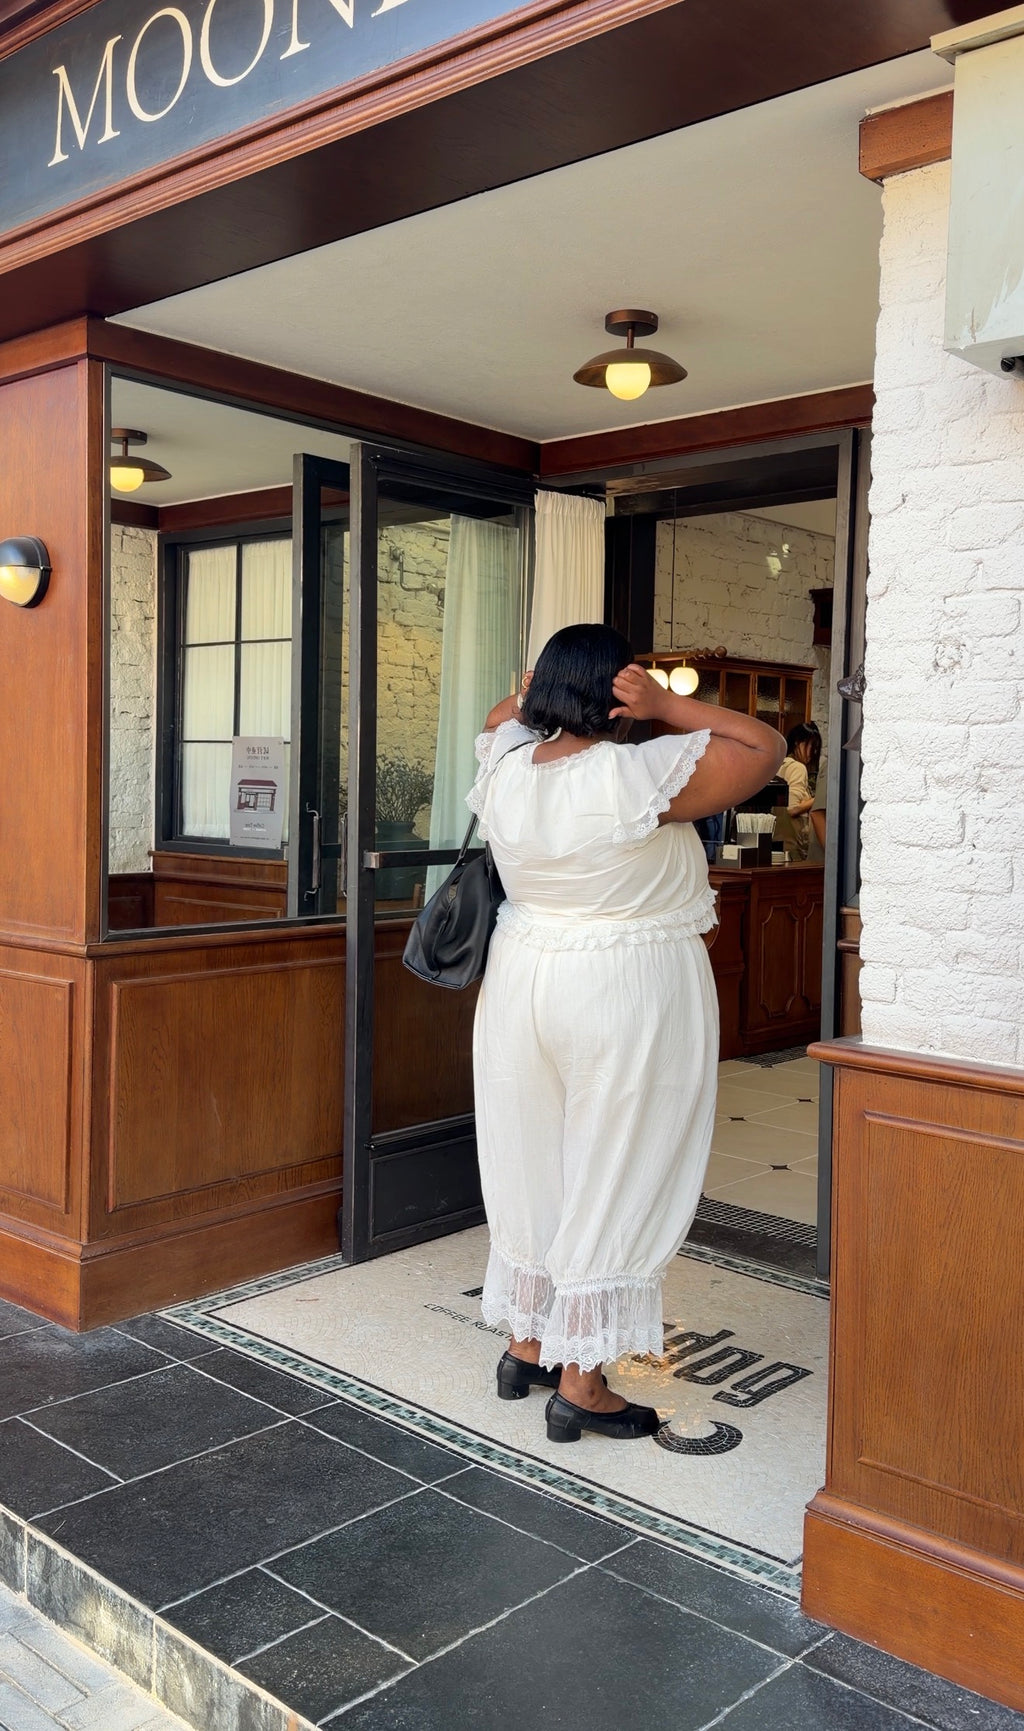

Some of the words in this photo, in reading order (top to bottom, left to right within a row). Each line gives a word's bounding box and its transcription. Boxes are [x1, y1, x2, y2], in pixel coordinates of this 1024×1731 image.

[48, 0, 406, 167] MOO
[424, 1303, 471, 1323] COFFEE
[472, 1321, 513, 1339] ROAST
